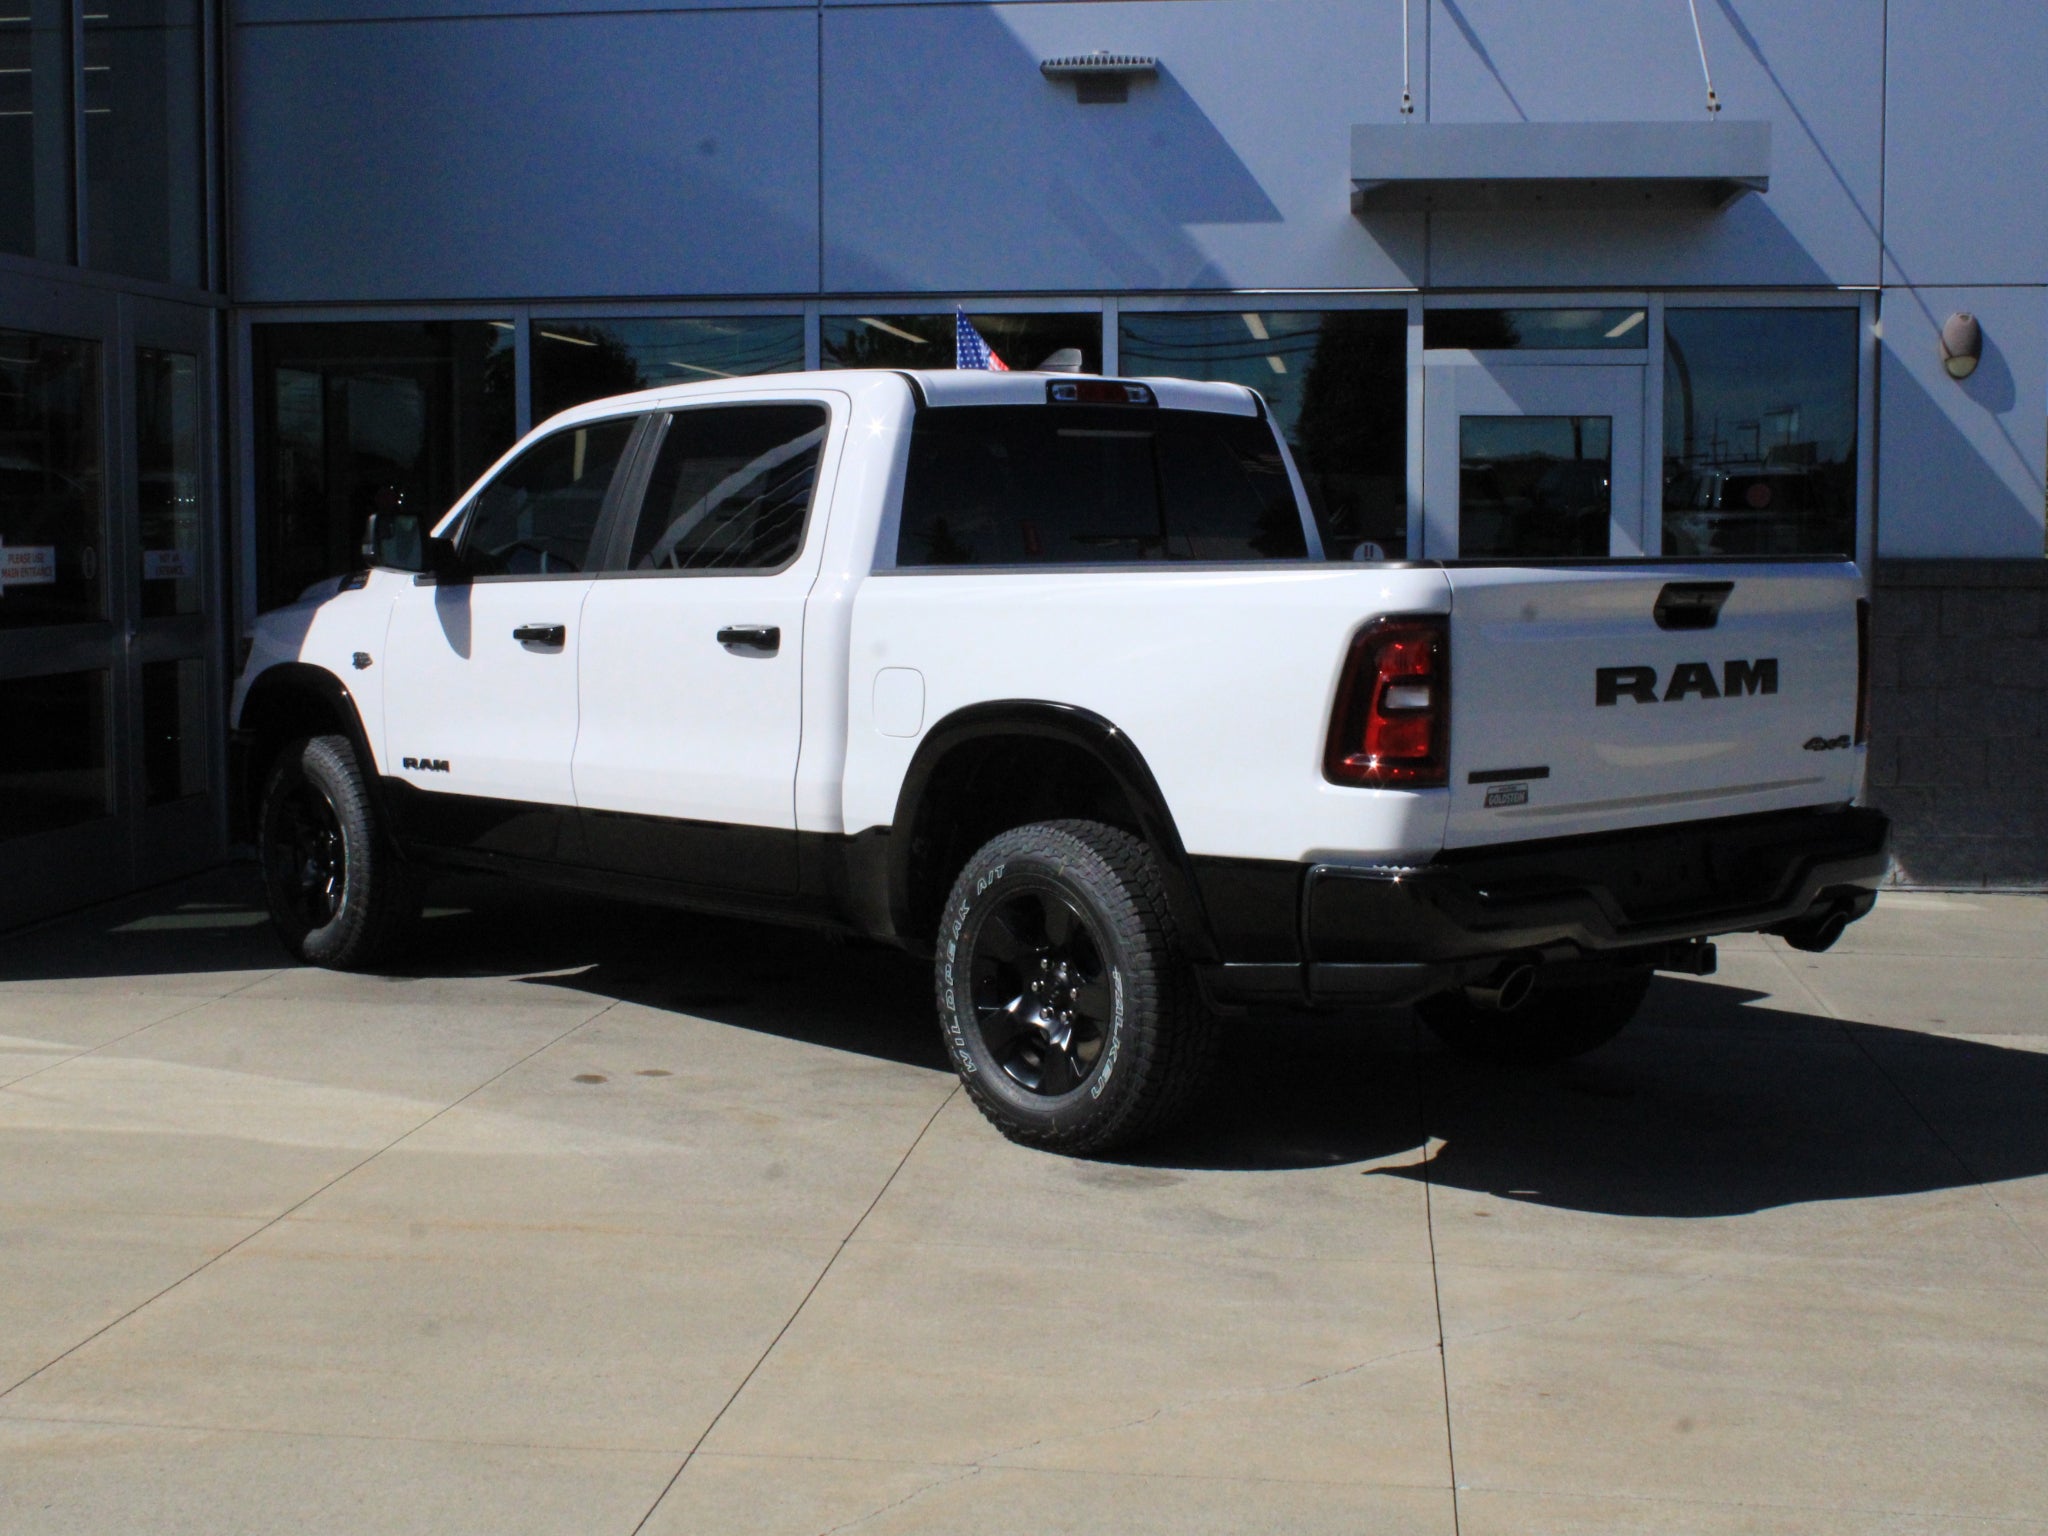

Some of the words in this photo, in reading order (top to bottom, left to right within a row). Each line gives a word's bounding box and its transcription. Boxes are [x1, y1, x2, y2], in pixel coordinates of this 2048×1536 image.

[1595, 658, 1778, 707] RAM
[403, 757, 450, 773] RAM
[1488, 791, 1526, 806] GOLDSTEIN
[944, 898, 977, 1073] WILDPEAK
[977, 865, 1005, 896] A/T
[1091, 965, 1123, 1099] FALKEN
